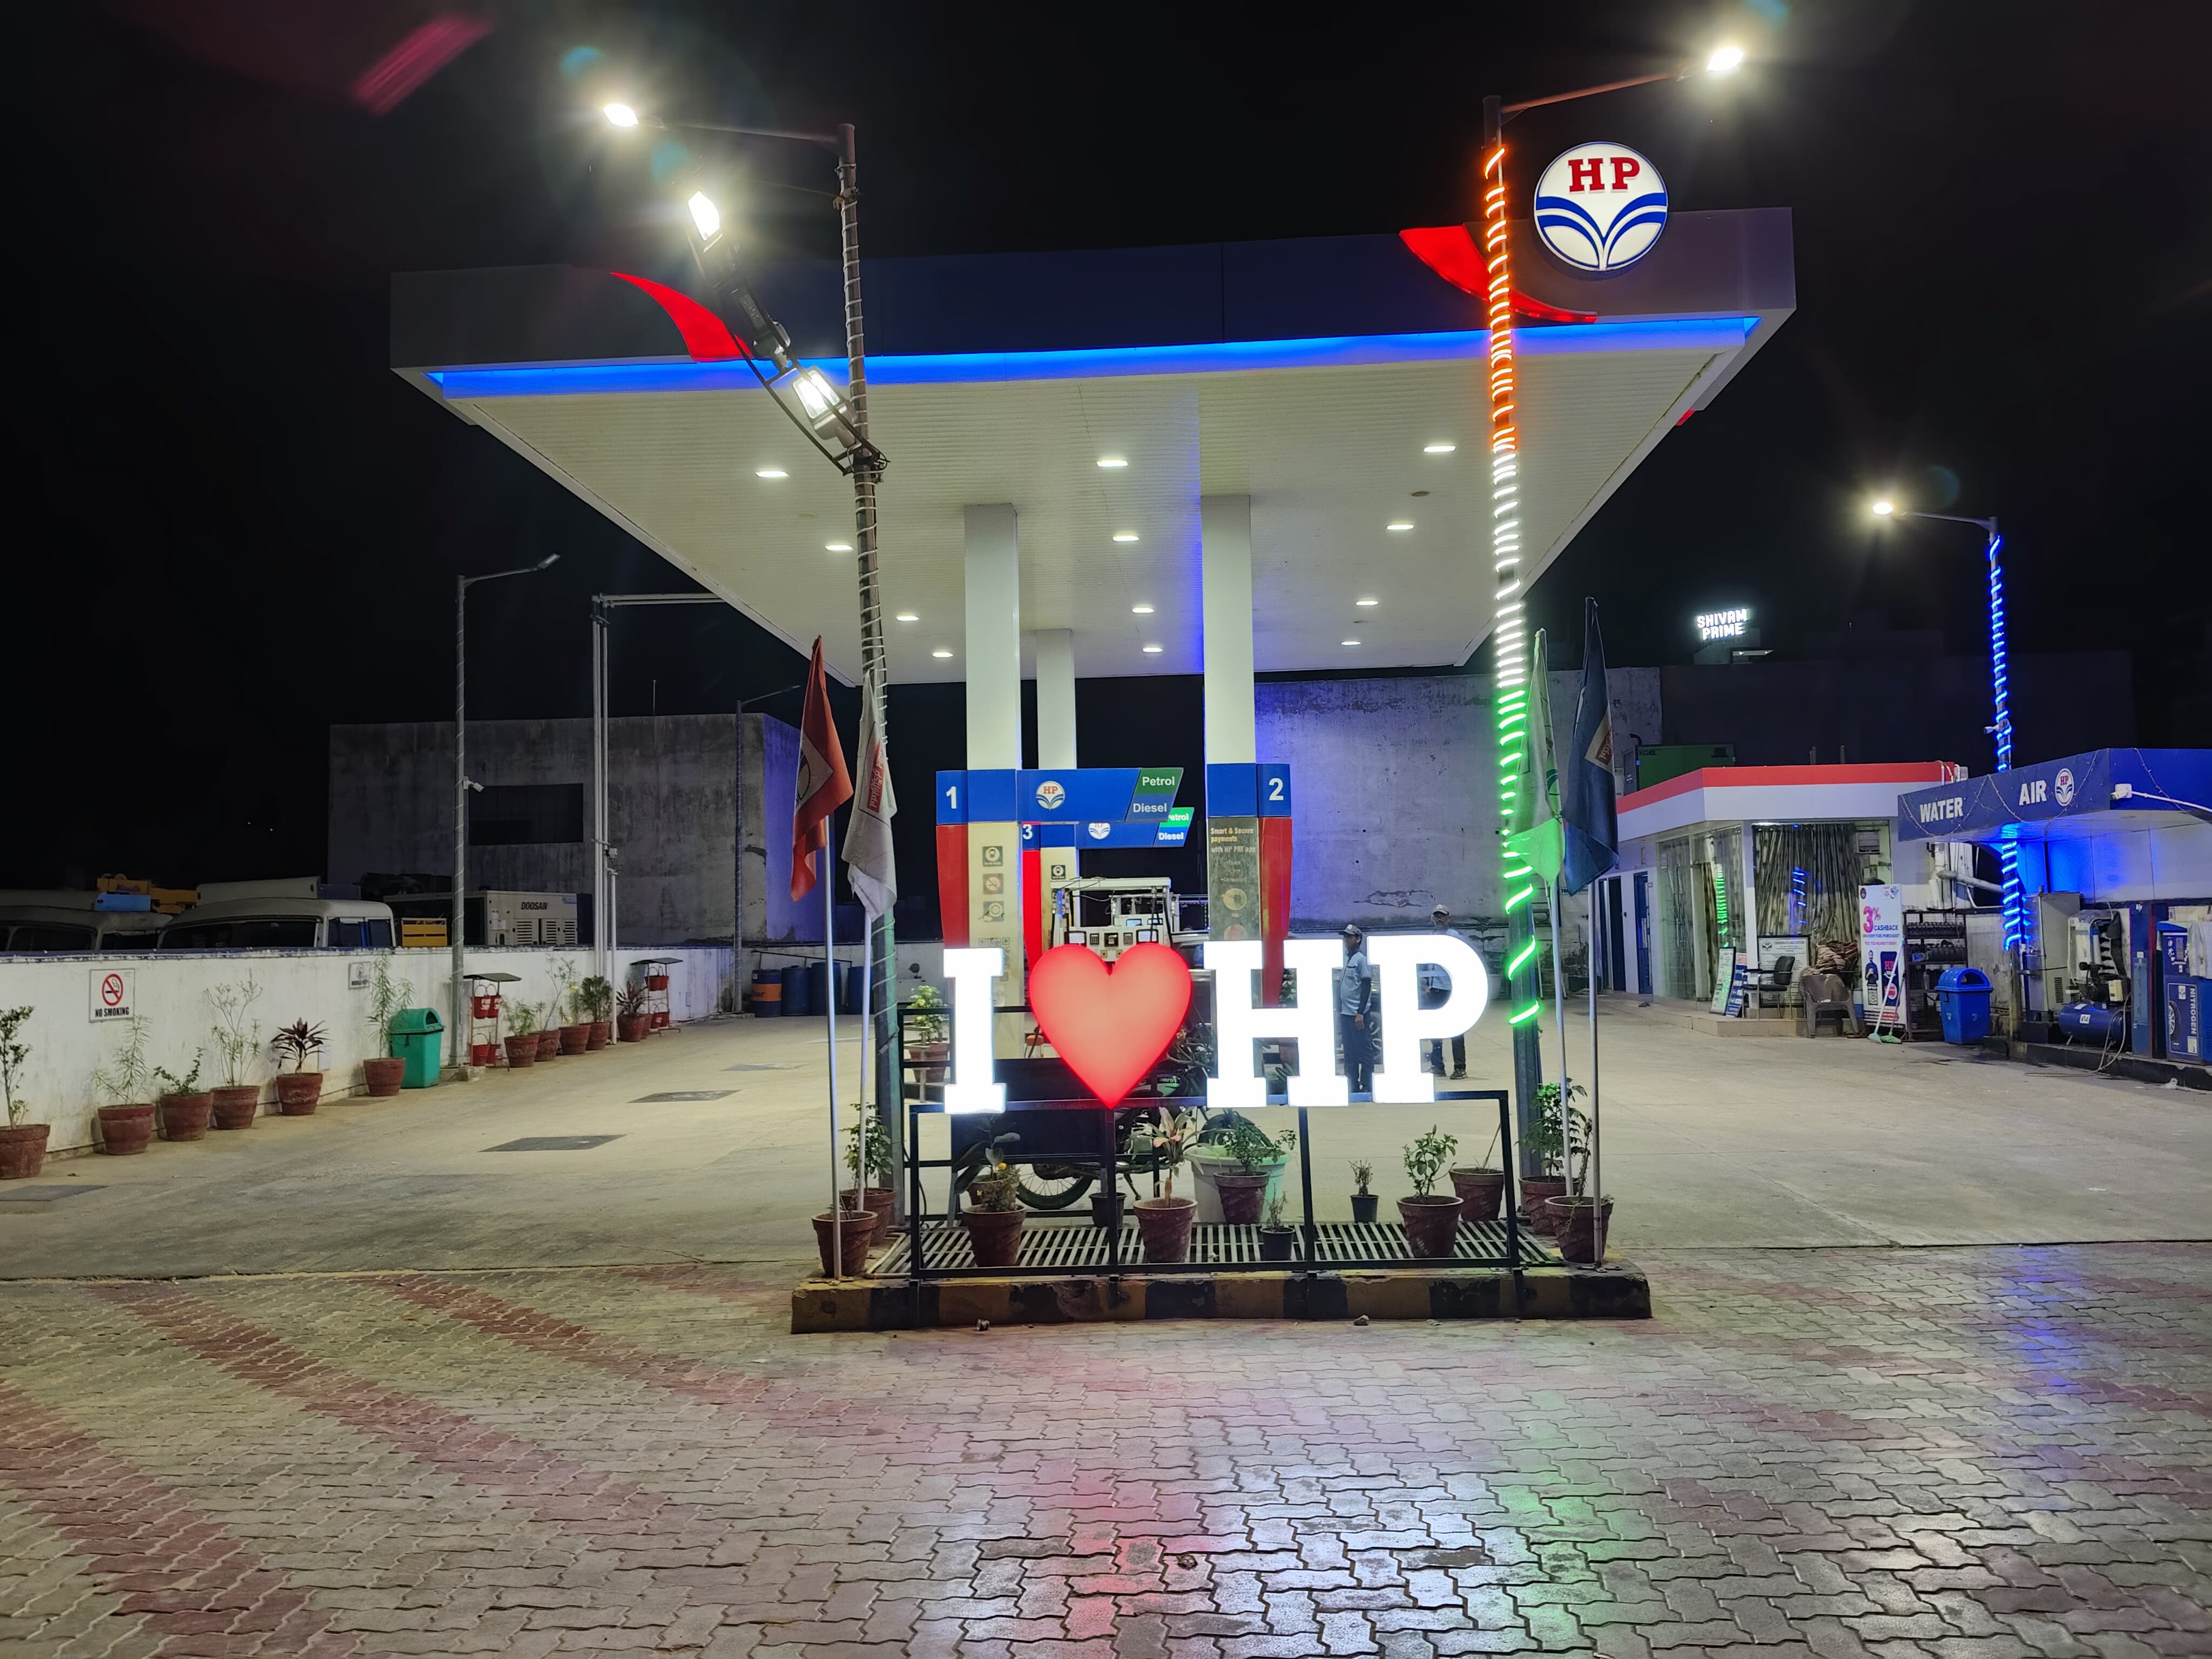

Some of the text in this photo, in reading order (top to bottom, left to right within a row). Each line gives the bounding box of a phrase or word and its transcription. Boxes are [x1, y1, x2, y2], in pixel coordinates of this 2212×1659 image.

[1568, 157, 1640, 192] HP
[1697, 609, 1748, 628] SHIVAM
[1702, 622, 1744, 640] PRIME
[1142, 777, 1175, 786] Petrol
[1269, 778, 1284, 801] 2
[2060, 775, 2069, 786] HP
[946, 786, 957, 809] 1
[2019, 780, 2047, 806] AIR
[1133, 803, 1167, 812] Diesel
[1920, 797, 1964, 823] WATER
[1022, 824, 1033, 839] 3
[521, 902, 548, 910] DOOSAN
[1863, 906, 1881, 933] 3%
[95, 1006, 130, 1017] NO SMOKING
[943, 935, 1488, 1114] I HP
